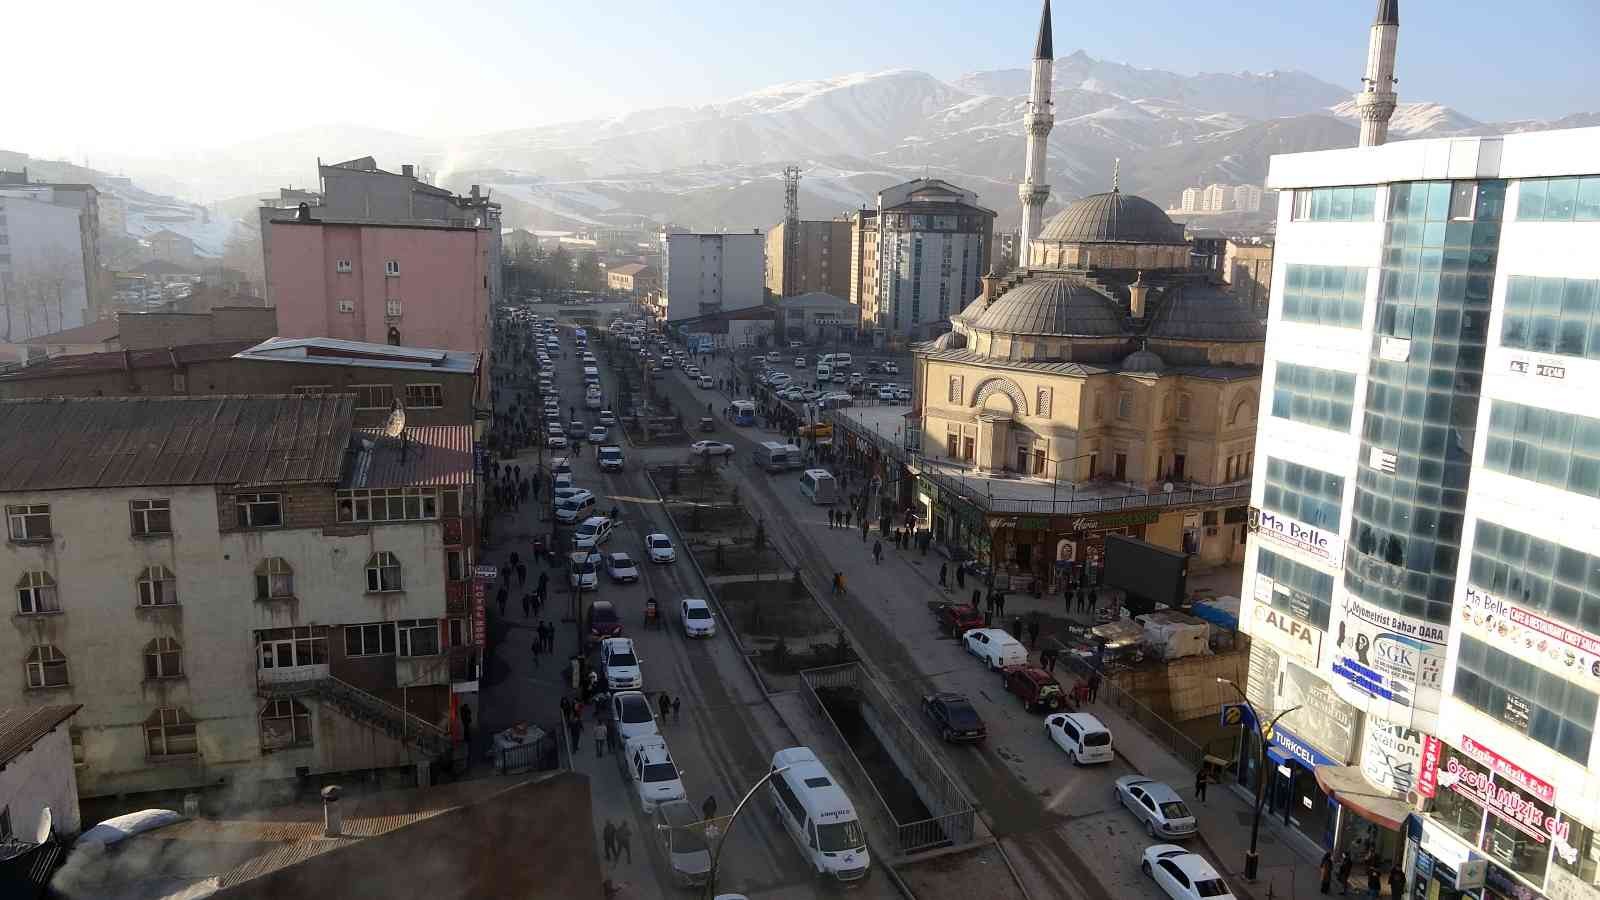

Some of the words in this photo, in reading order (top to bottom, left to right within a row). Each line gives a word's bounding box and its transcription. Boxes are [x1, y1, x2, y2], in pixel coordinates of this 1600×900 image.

[1261, 511, 1284, 532] Ma
[1290, 522, 1329, 549] Belle
[1466, 587, 1481, 607] Ma
[1484, 594, 1508, 616] Belle
[1265, 610, 1313, 645] ALFA
[1391, 617, 1417, 635] Bahar
[1418, 625, 1444, 641] DARA
[1376, 640, 1413, 668] SGK
[1275, 731, 1316, 767] TURKCELL
[1446, 757, 1496, 799] ÖZGÜR
[1496, 787, 1544, 826] MÜZİK
